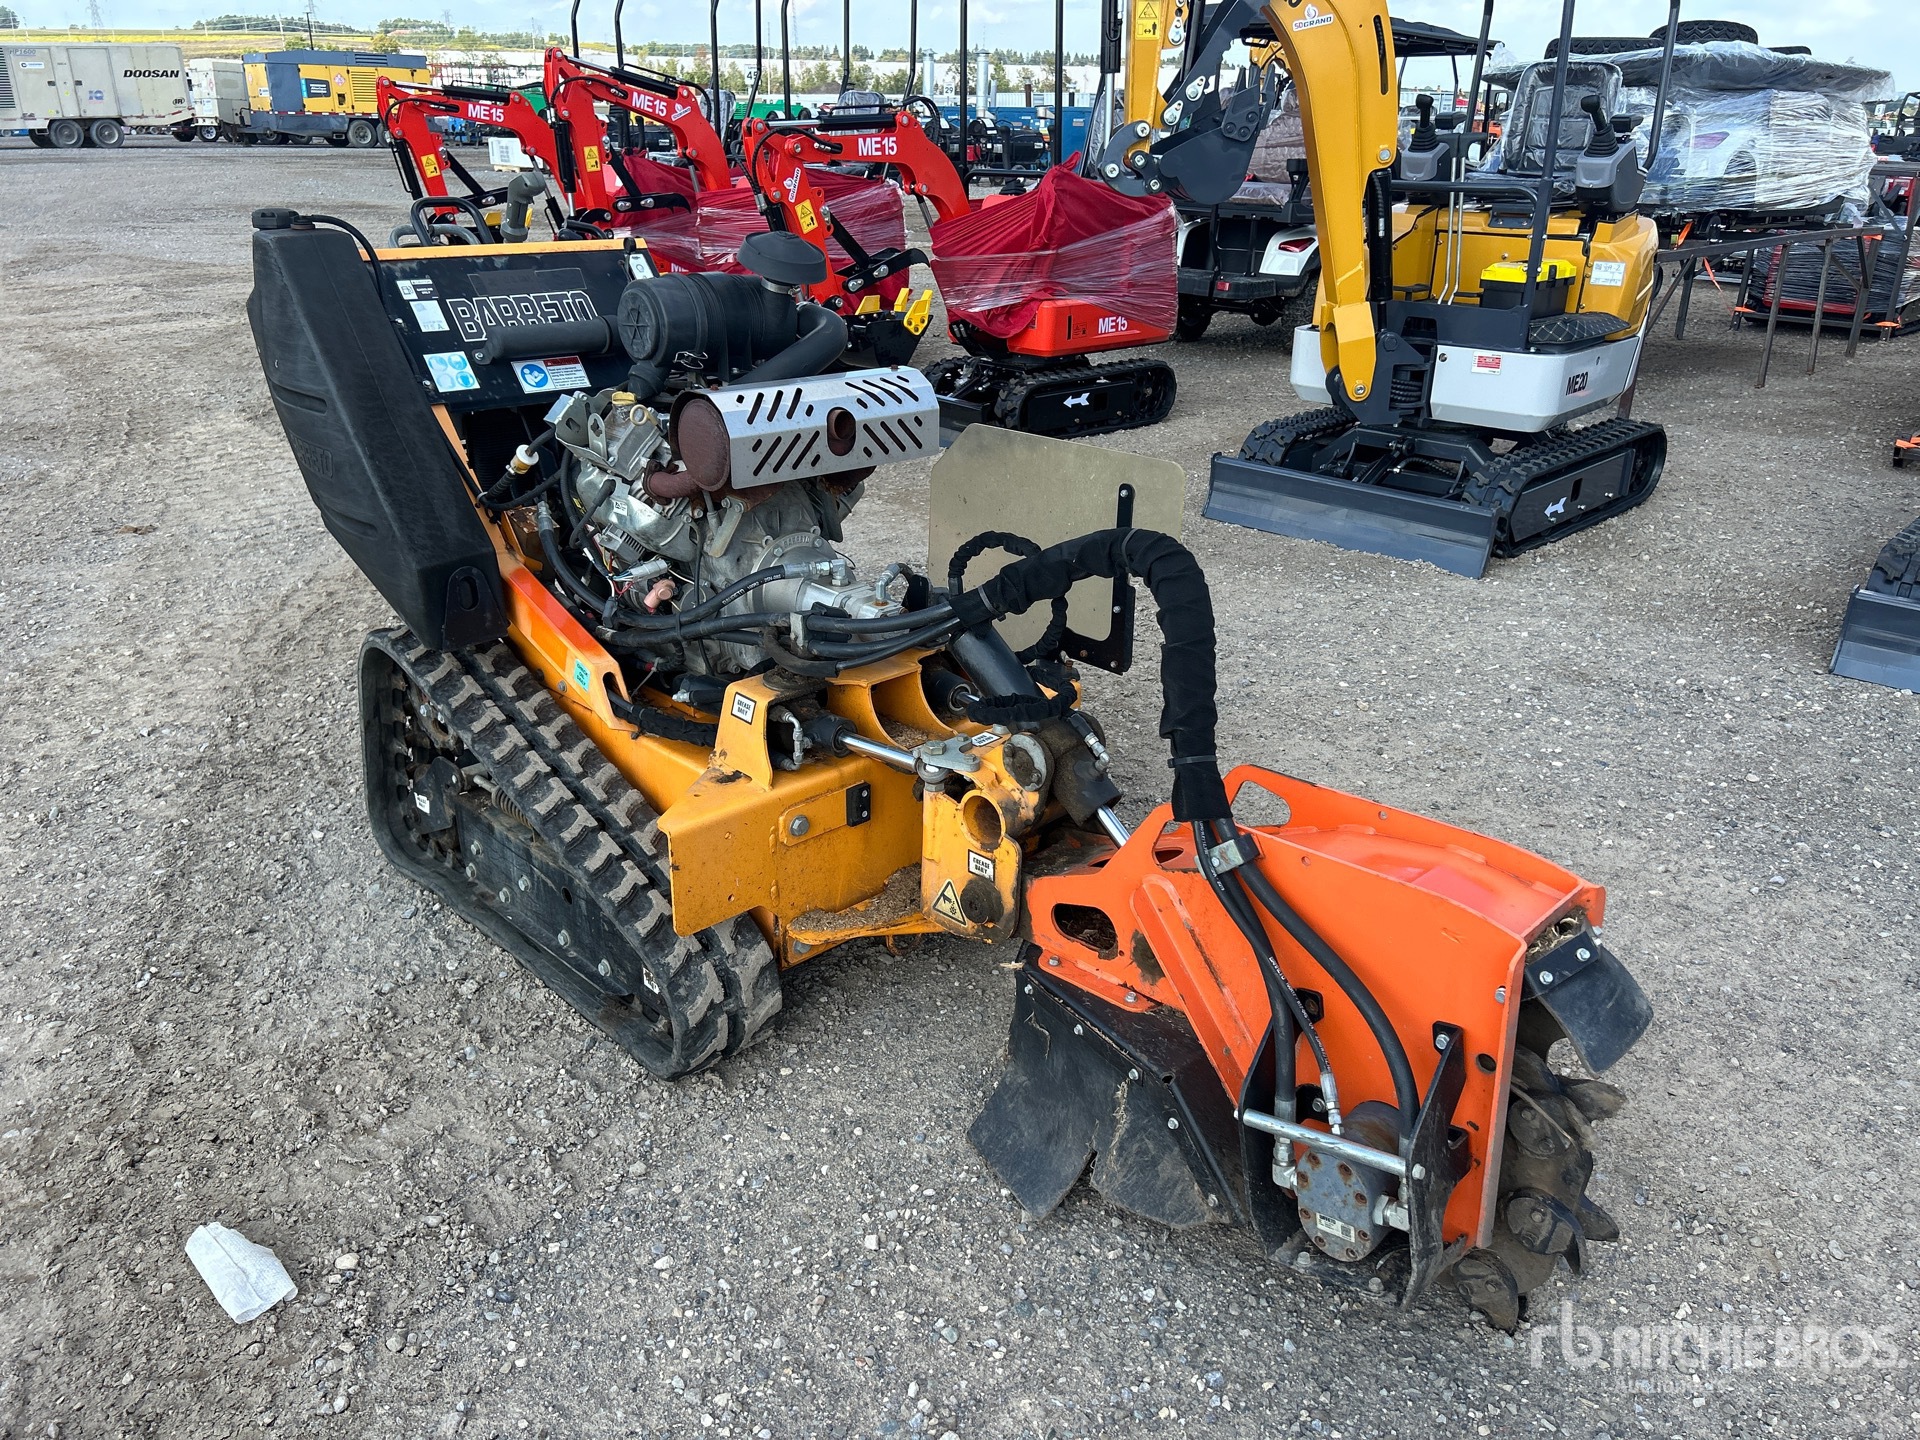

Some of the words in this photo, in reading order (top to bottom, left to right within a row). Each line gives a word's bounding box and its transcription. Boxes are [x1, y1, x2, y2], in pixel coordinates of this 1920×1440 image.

[123, 69, 180, 79] DOOSAN
[945, 86, 954, 94] 29
[631, 91, 667, 117] ME15
[468, 104, 504, 122] ME15
[858, 137, 897, 156] ME15
[1098, 316, 1128, 334] ME15
[1566, 372, 1588, 395] ME20
[737, 699, 752, 710] GREASE
[737, 706, 748, 716] DAILY
[973, 857, 990, 869] GREASE
[975, 864, 987, 874] DAILY
